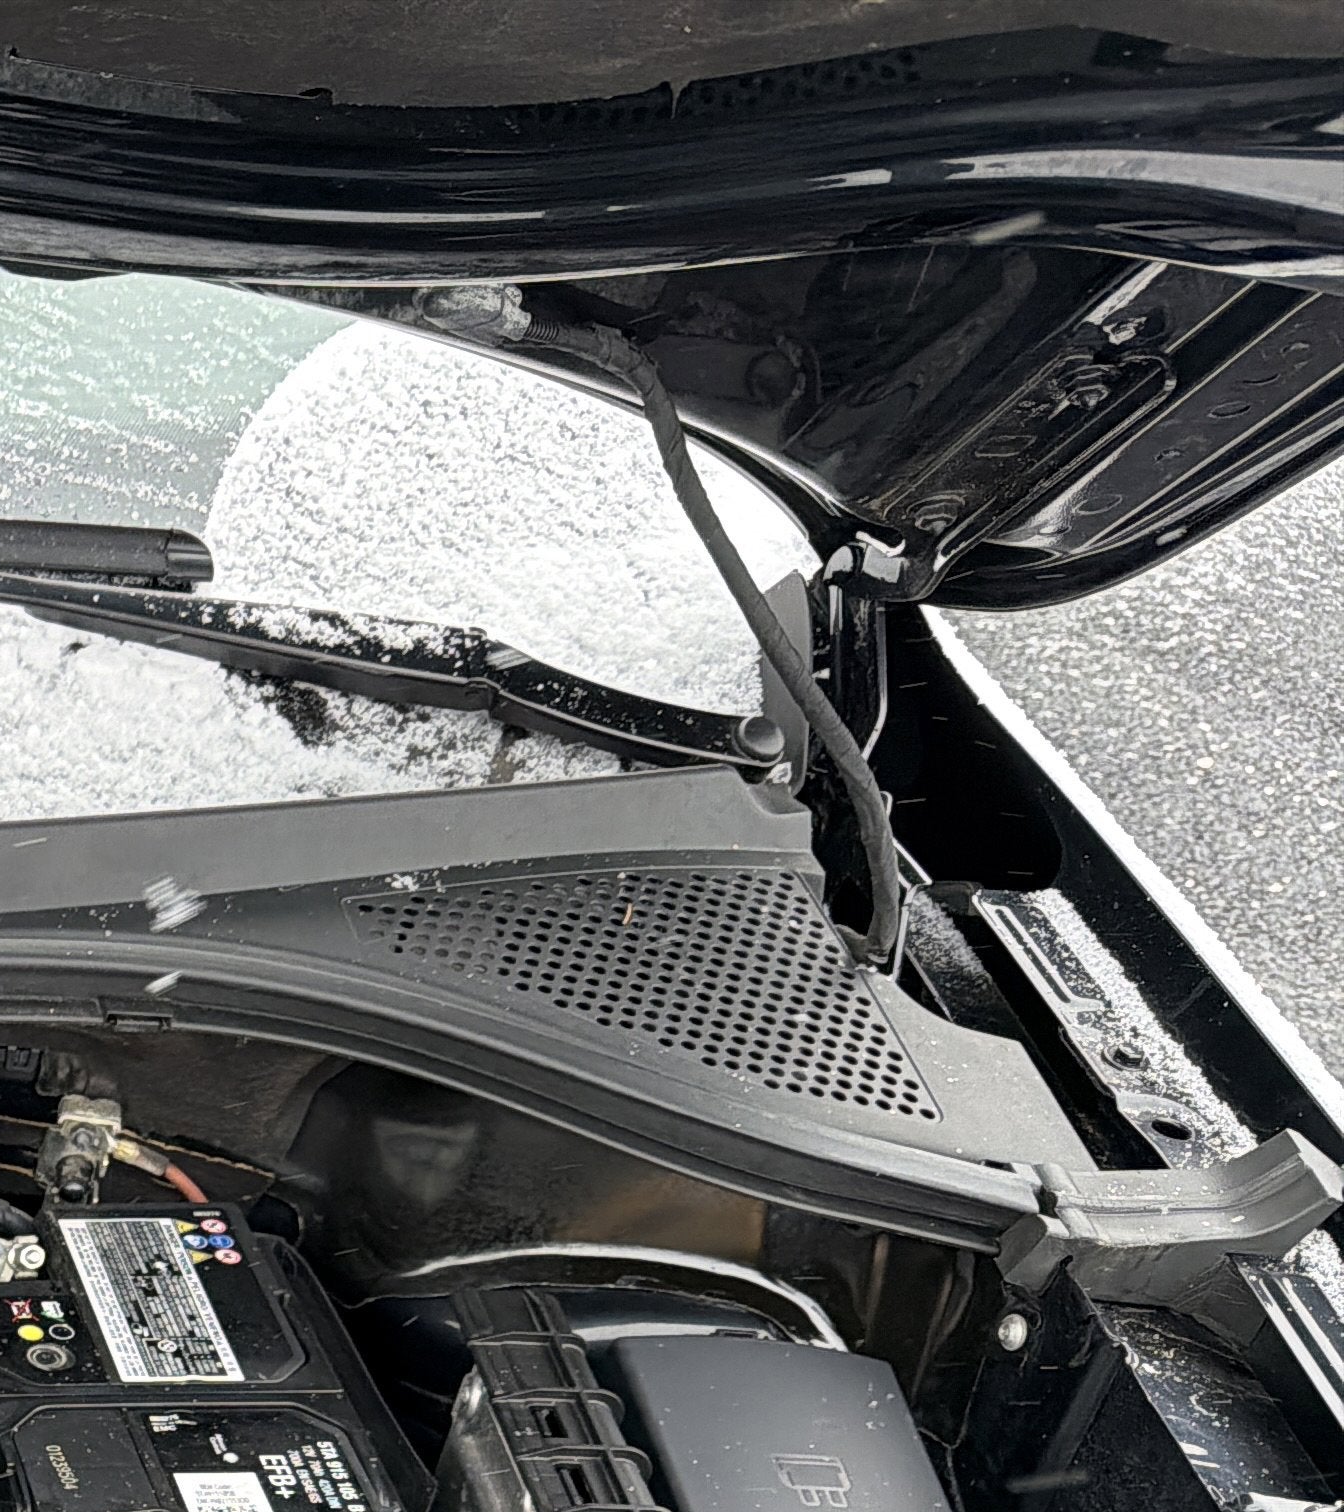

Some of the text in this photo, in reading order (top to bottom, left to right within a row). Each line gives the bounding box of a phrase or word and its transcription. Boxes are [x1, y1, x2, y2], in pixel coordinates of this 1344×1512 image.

[259, 1454, 296, 1500] EFB+
[326, 1457, 346, 1479] 915
[337, 1478, 359, 1501] 105
